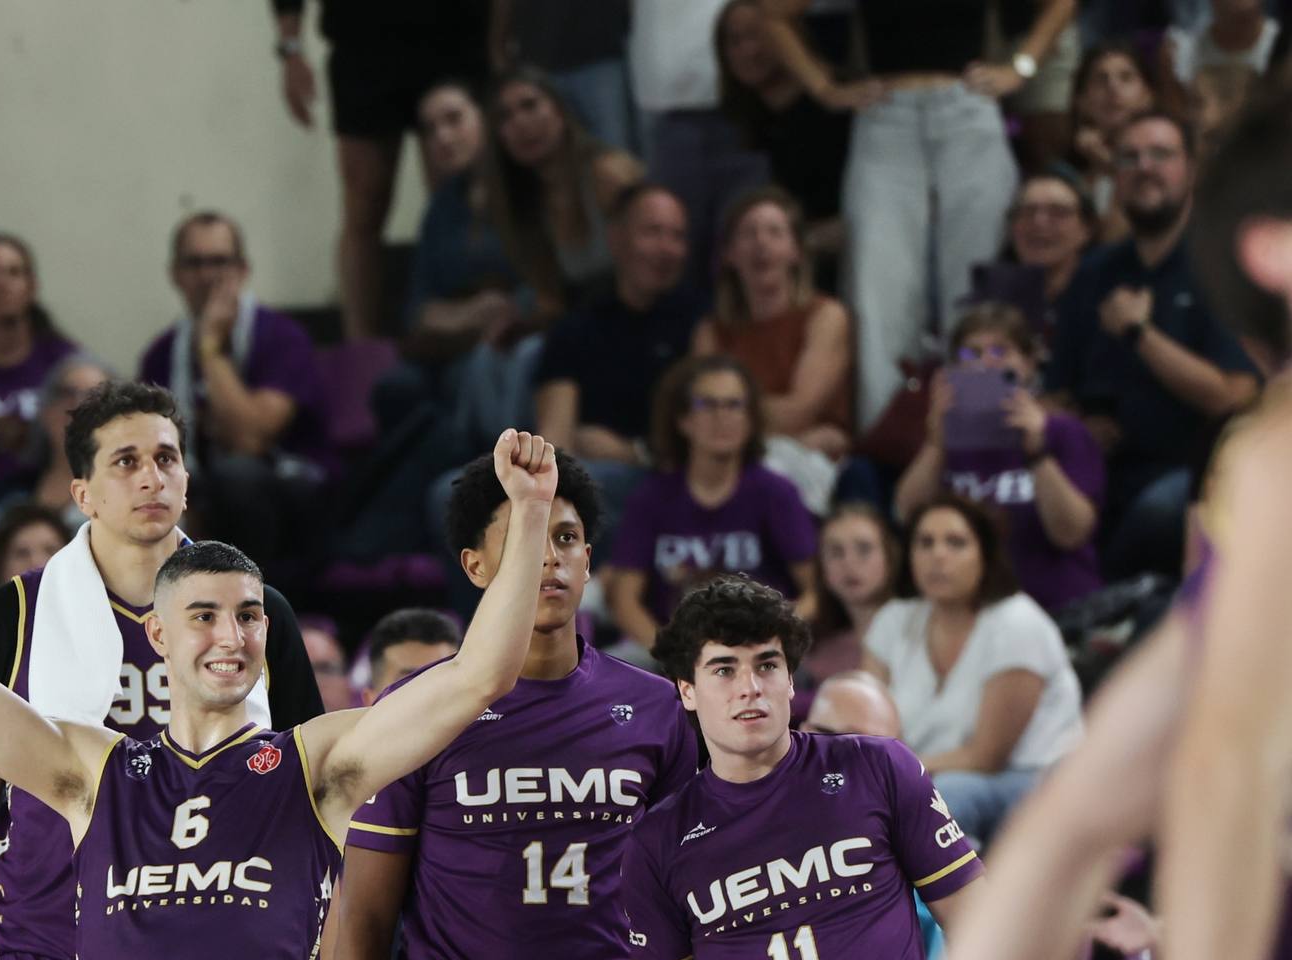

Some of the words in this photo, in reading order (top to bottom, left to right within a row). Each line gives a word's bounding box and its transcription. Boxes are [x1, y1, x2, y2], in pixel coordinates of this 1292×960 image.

[110, 662, 172, 725] 99
[454, 768, 642, 807] UEMC
[170, 795, 211, 849] 6
[463, 811, 633, 824] UNIVERSIDAD
[106, 856, 272, 899] UEMC
[522, 841, 590, 905] 14
[687, 837, 874, 924] UEMC
[106, 894, 269, 915] UNIVERSIDAD
